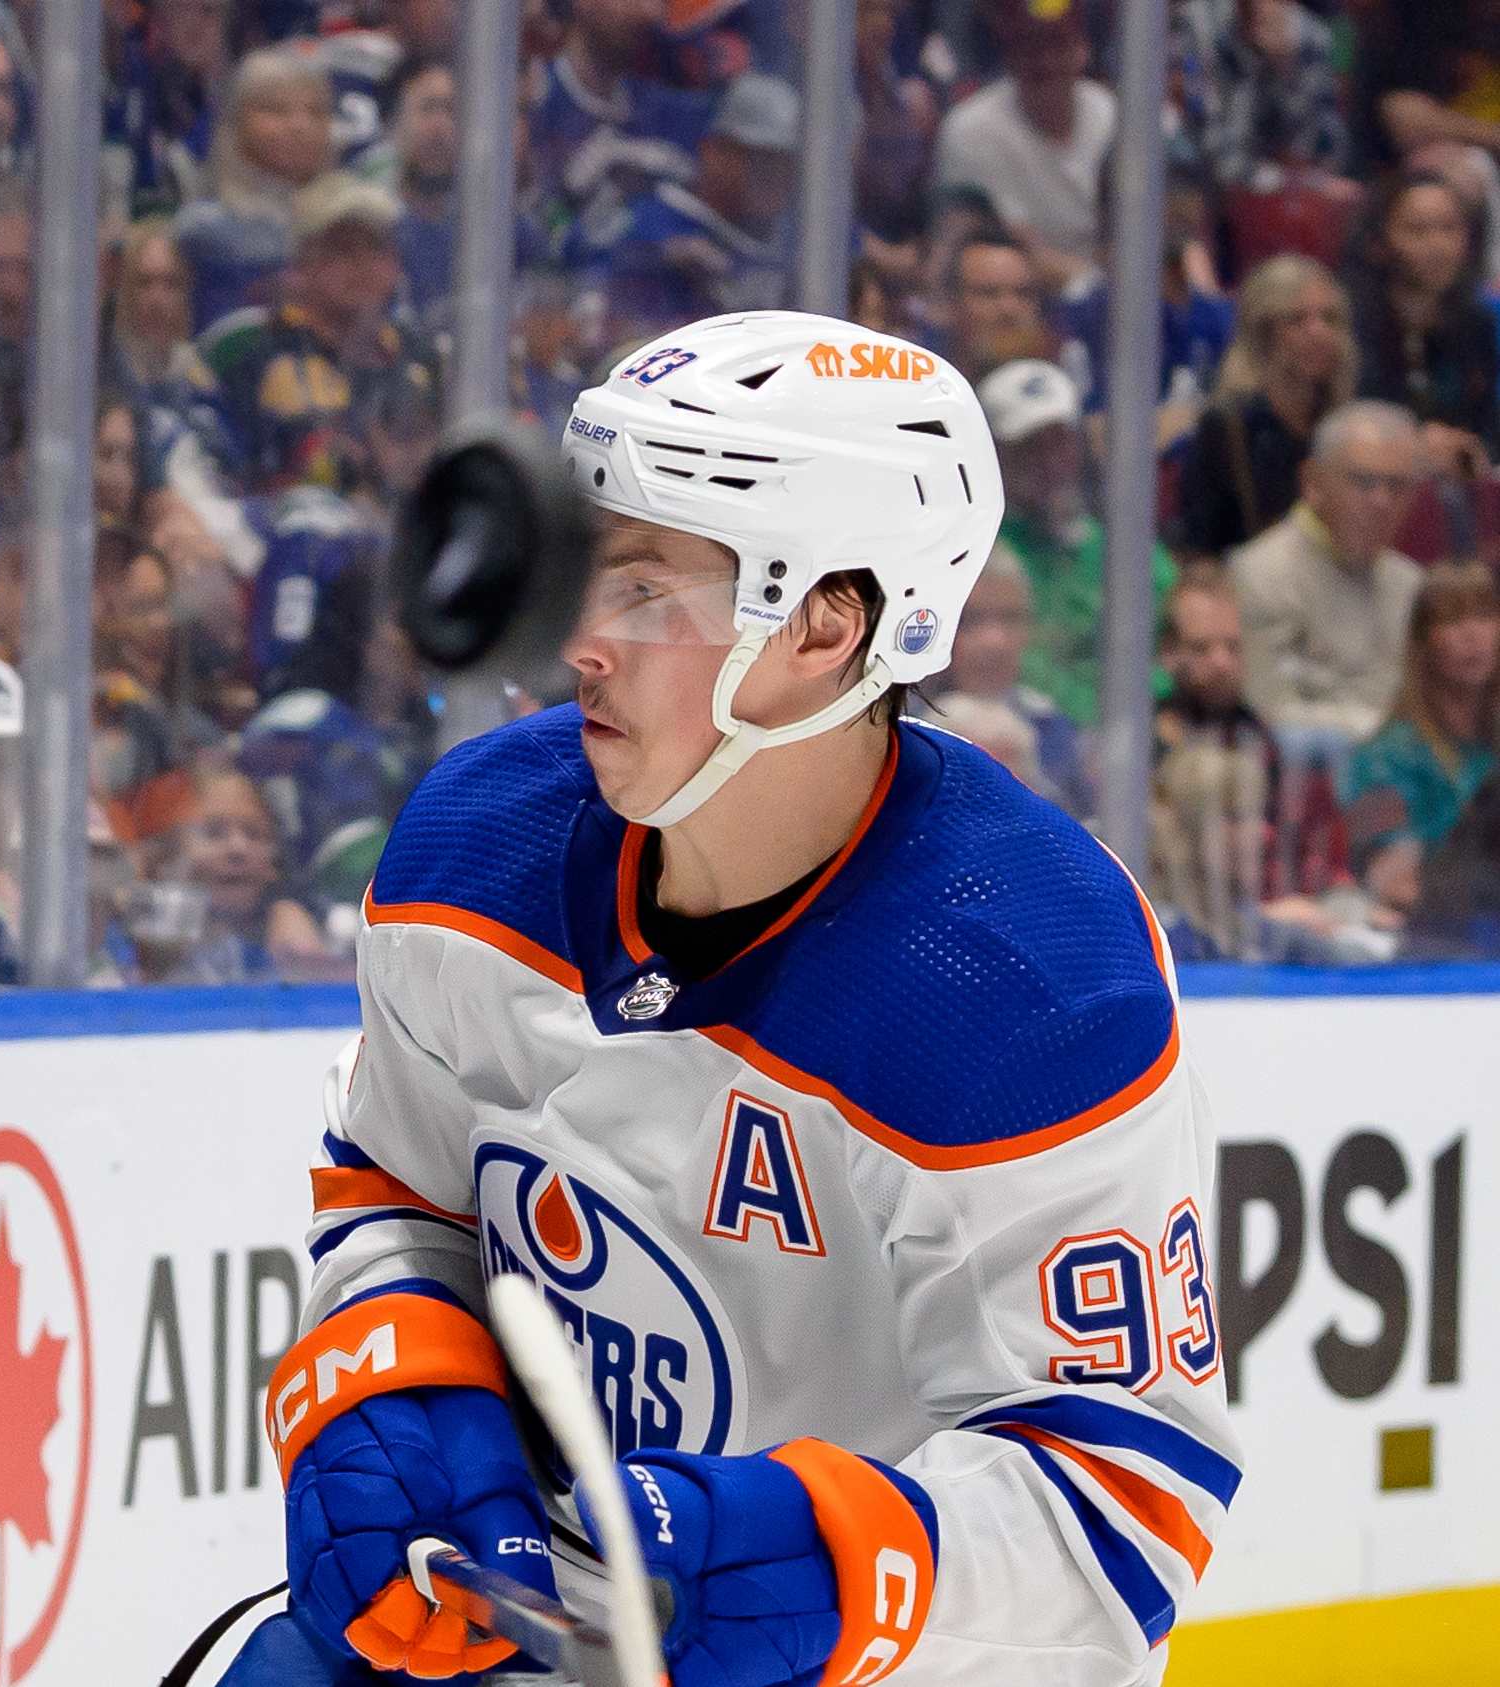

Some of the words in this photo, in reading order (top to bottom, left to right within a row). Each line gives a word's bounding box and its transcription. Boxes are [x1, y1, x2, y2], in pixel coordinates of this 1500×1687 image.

[849, 343, 936, 382] SKIP
[703, 1088, 828, 1259] A
[1038, 1196, 1222, 1396] 93
[271, 1322, 397, 1466] CM
[627, 1464, 674, 1545] CCM
